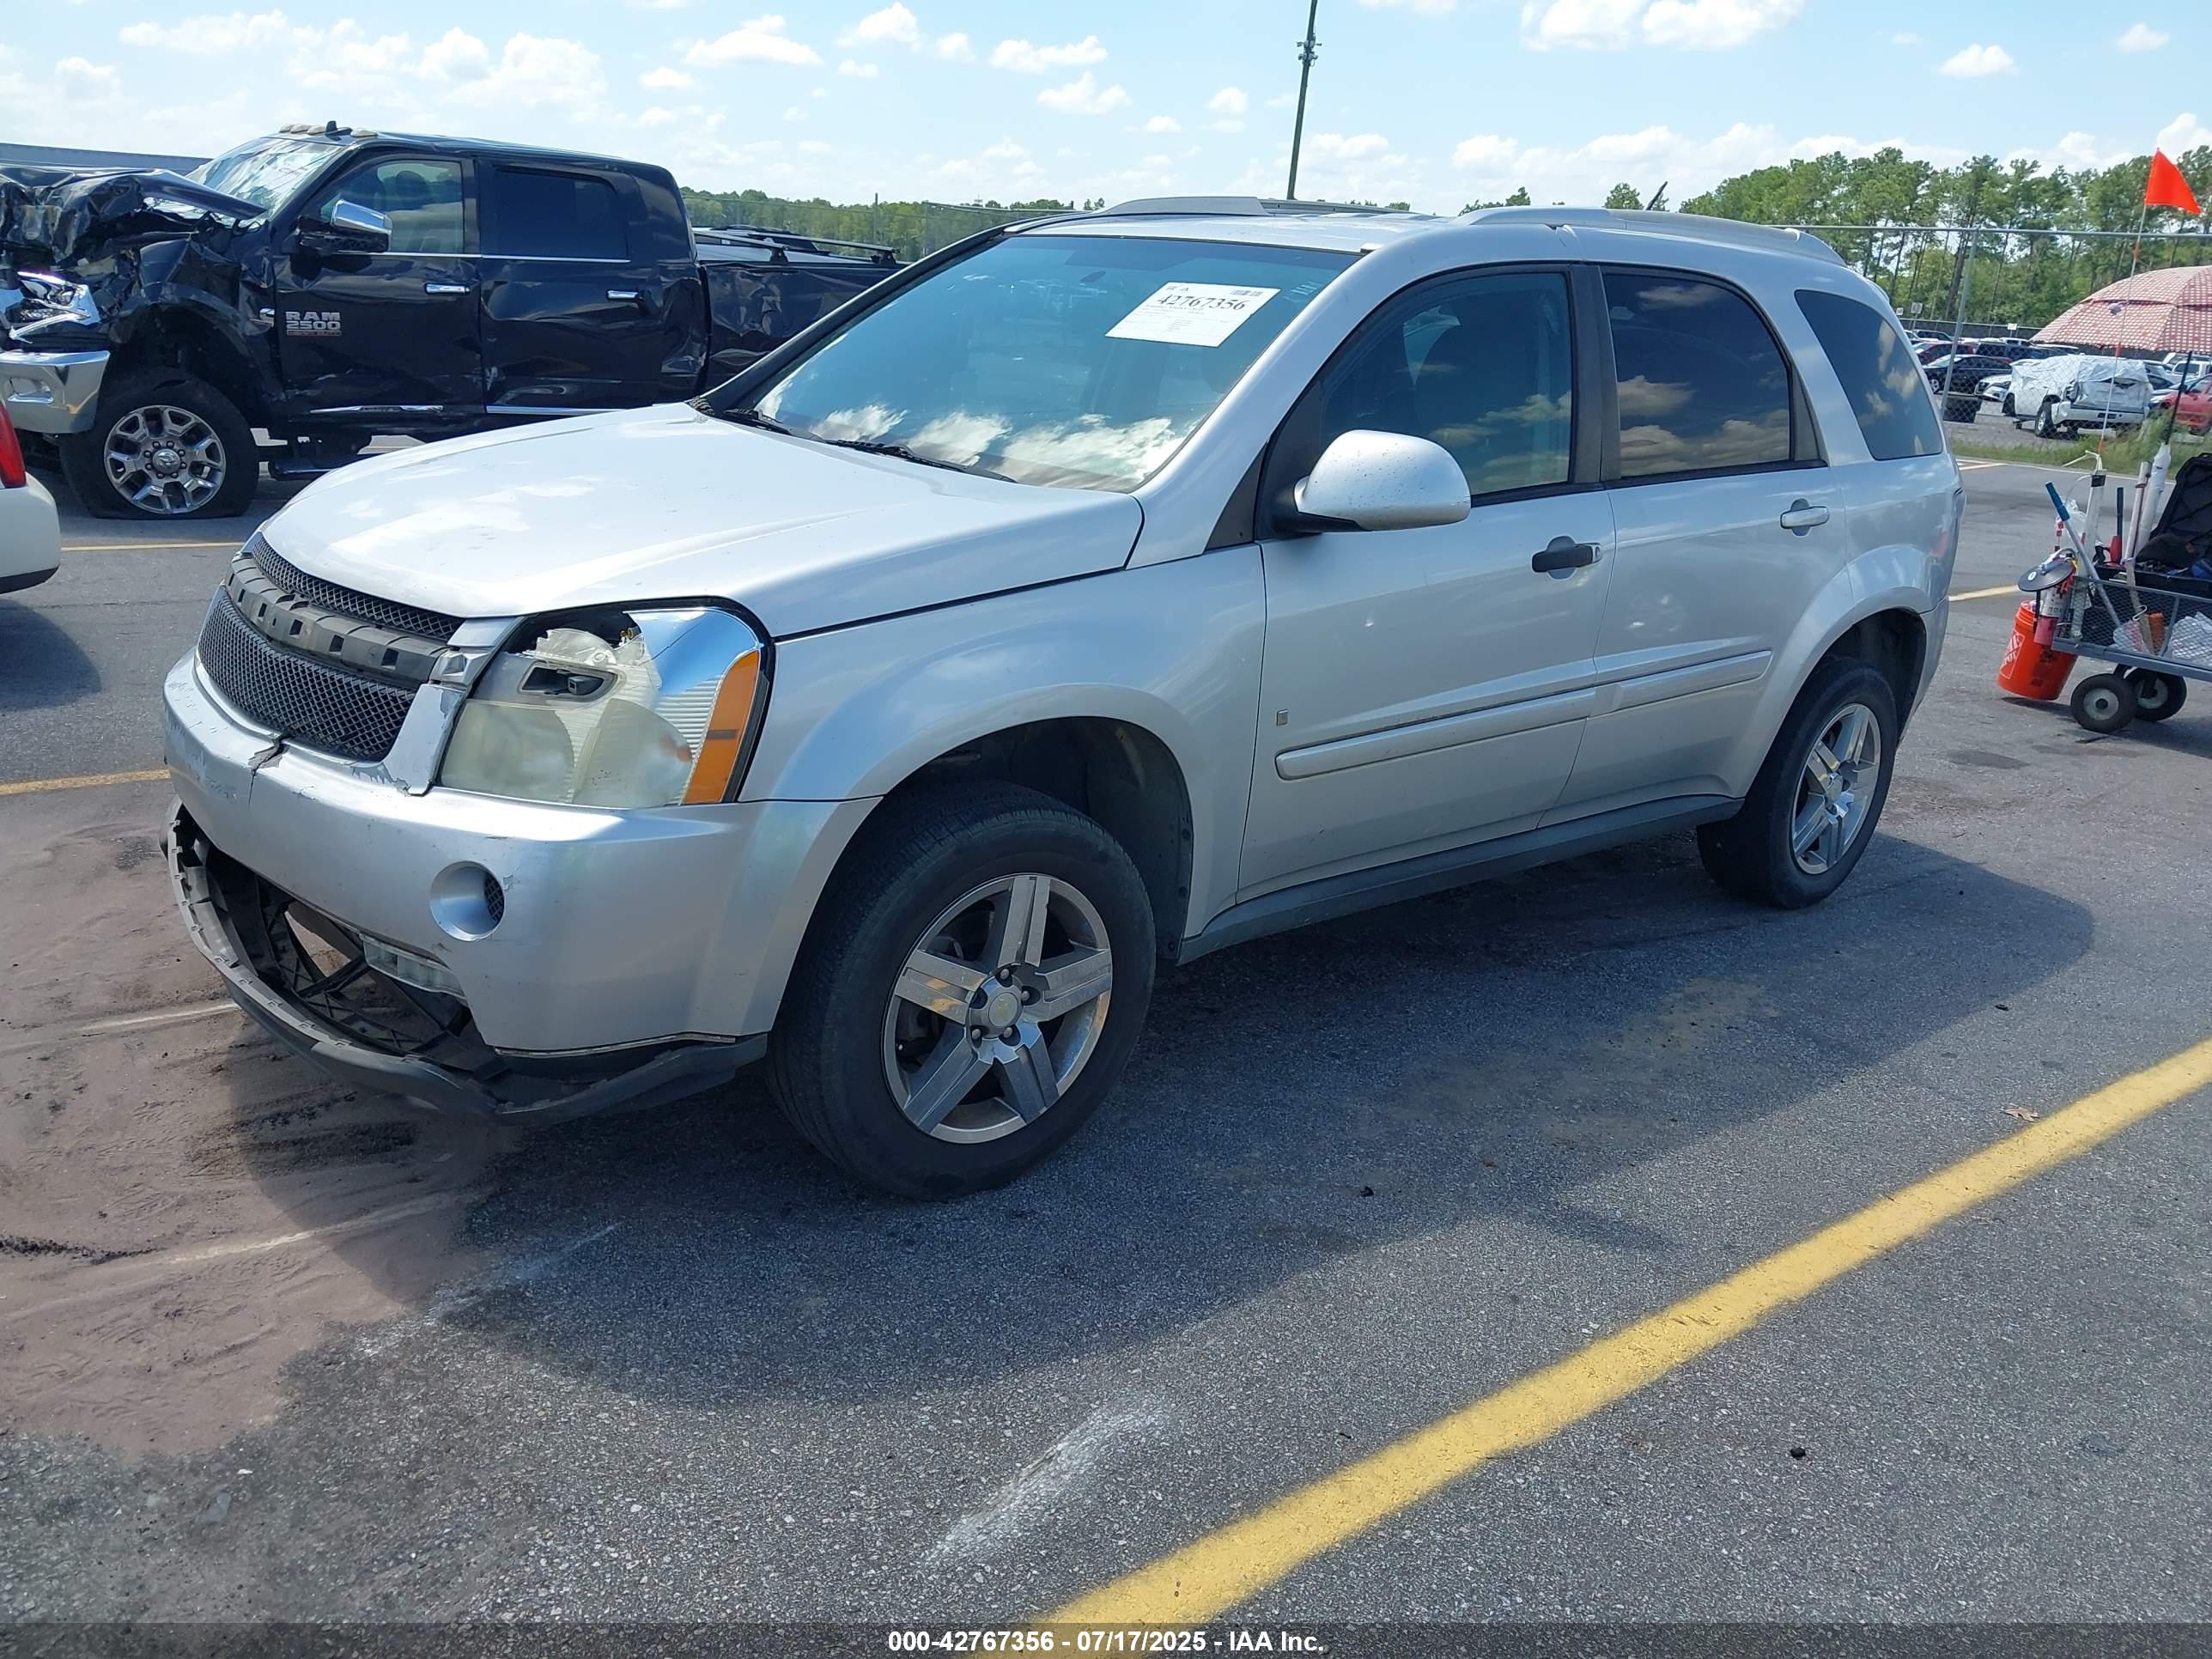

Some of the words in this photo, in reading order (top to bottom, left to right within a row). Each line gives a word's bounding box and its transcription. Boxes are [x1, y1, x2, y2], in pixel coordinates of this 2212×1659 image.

[1158, 294, 1250, 310] 42767356
[286, 312, 340, 320] RAM
[286, 321, 341, 330] 2500
